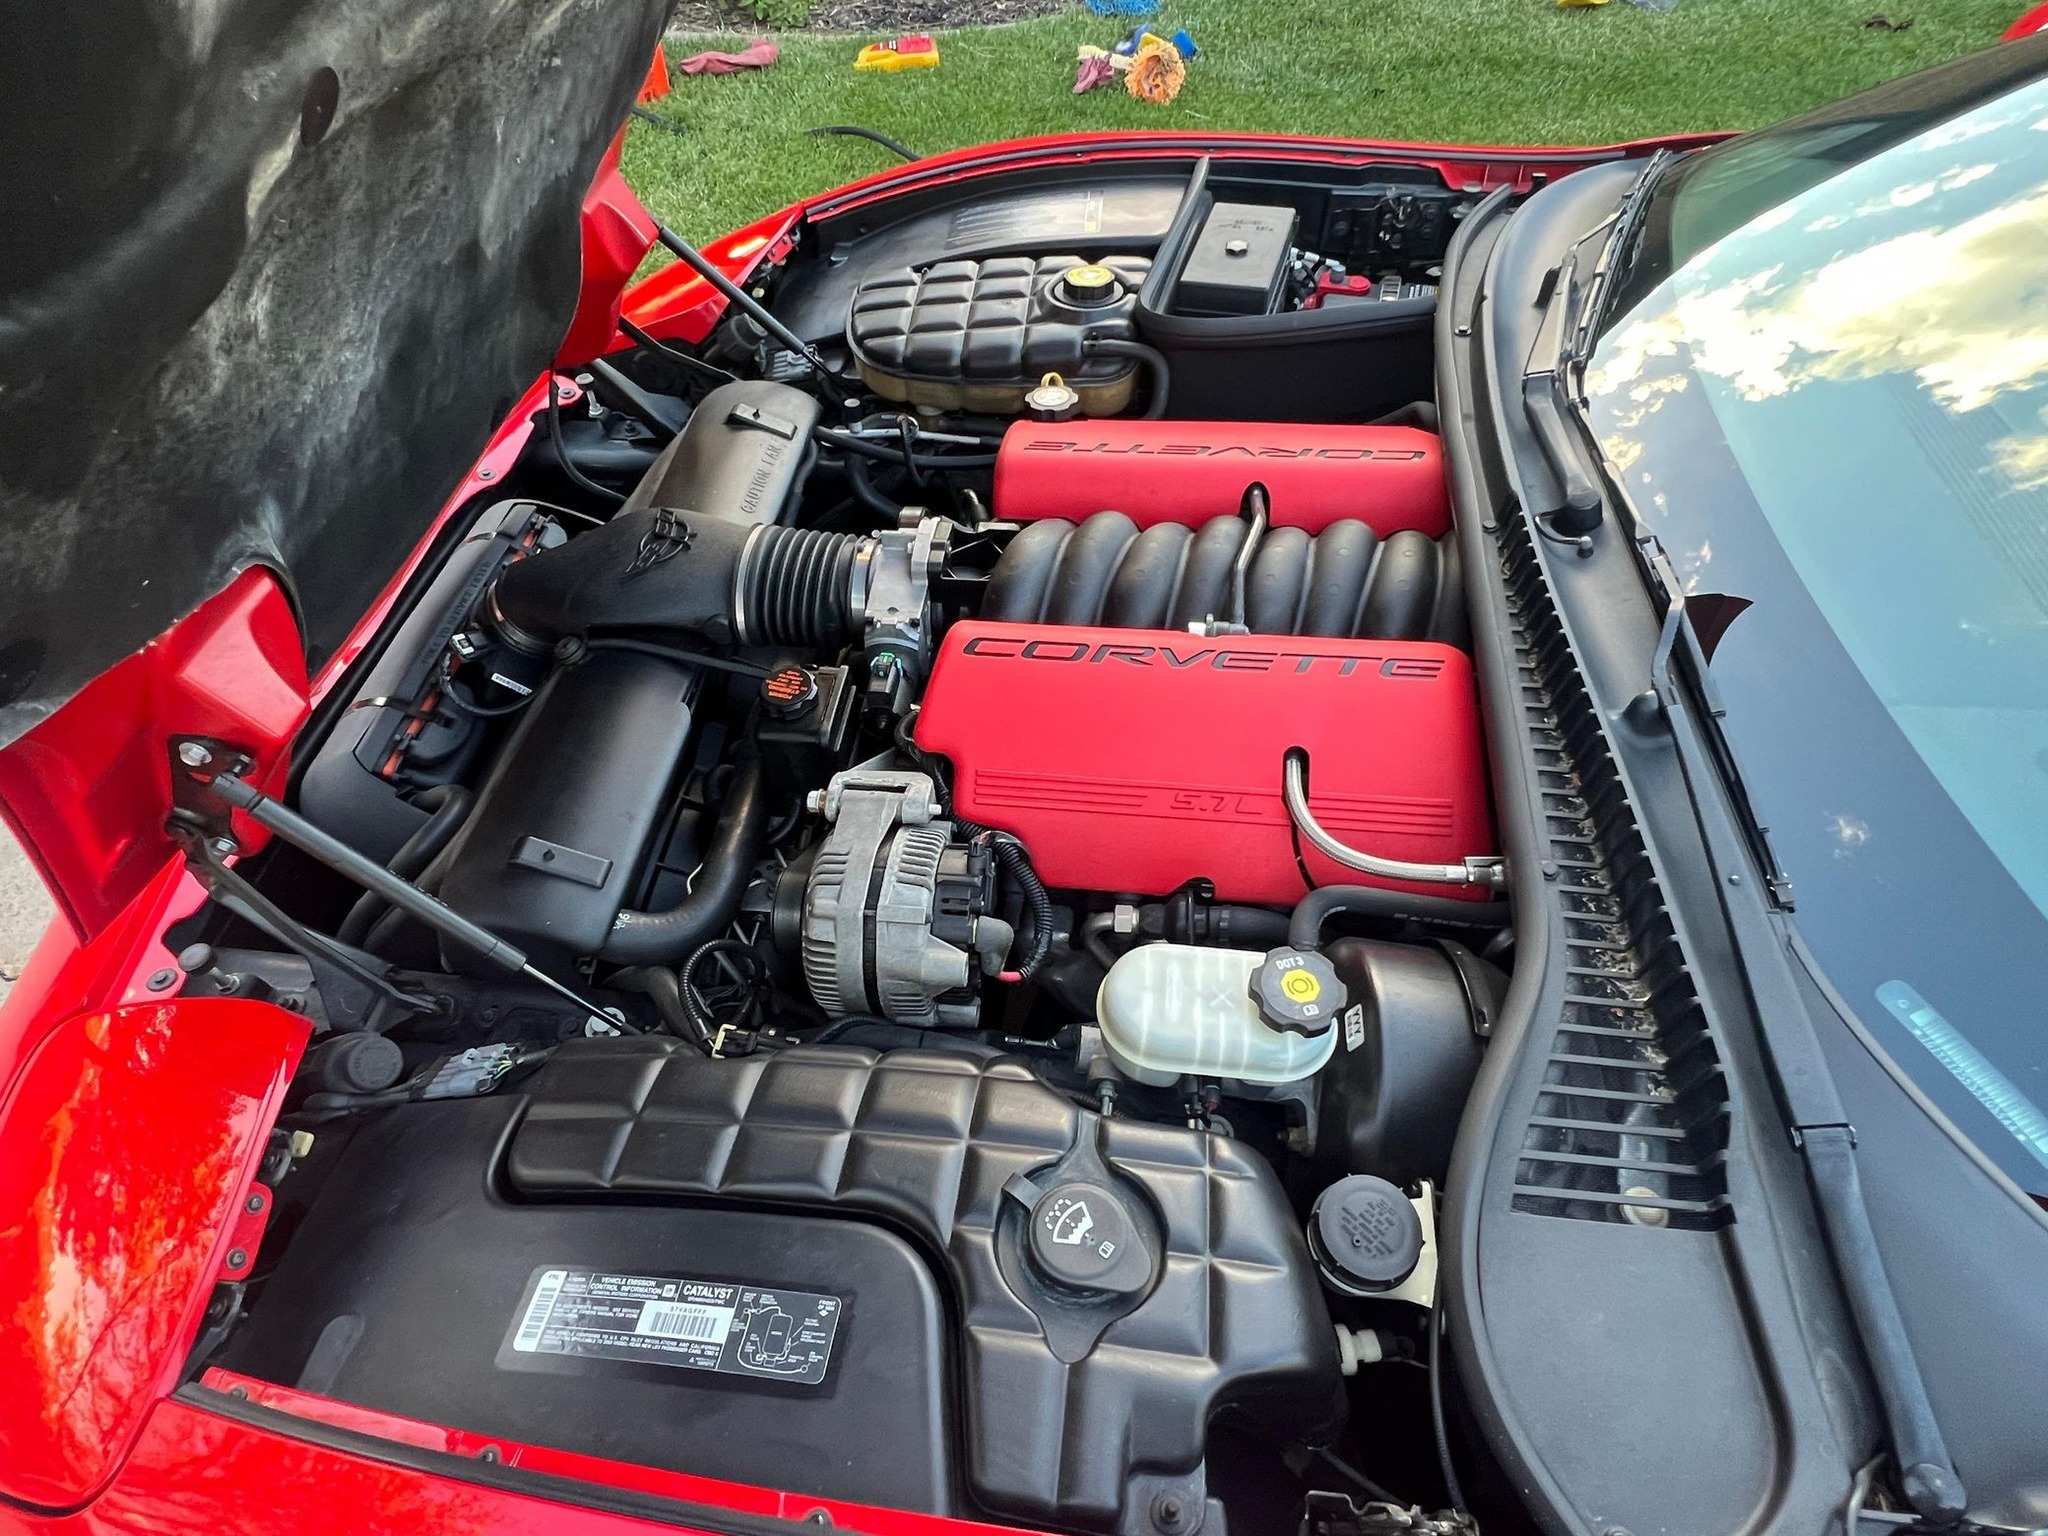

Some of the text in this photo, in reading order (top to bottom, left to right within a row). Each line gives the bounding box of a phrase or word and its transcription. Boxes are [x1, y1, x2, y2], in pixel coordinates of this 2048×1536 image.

[1024, 440, 1426, 461] CORVETTE
[740, 468, 771, 514] CAUTION
[962, 636, 1446, 679] CORVETTE
[1170, 791, 1264, 815] 5.7L
[1275, 957, 1296, 970] DOT
[590, 1283, 619, 1292] CONTROL
[620, 1285, 663, 1294] INFORMATION
[601, 1276, 626, 1285] VEHICLE
[683, 1284, 734, 1300] CATALYST
